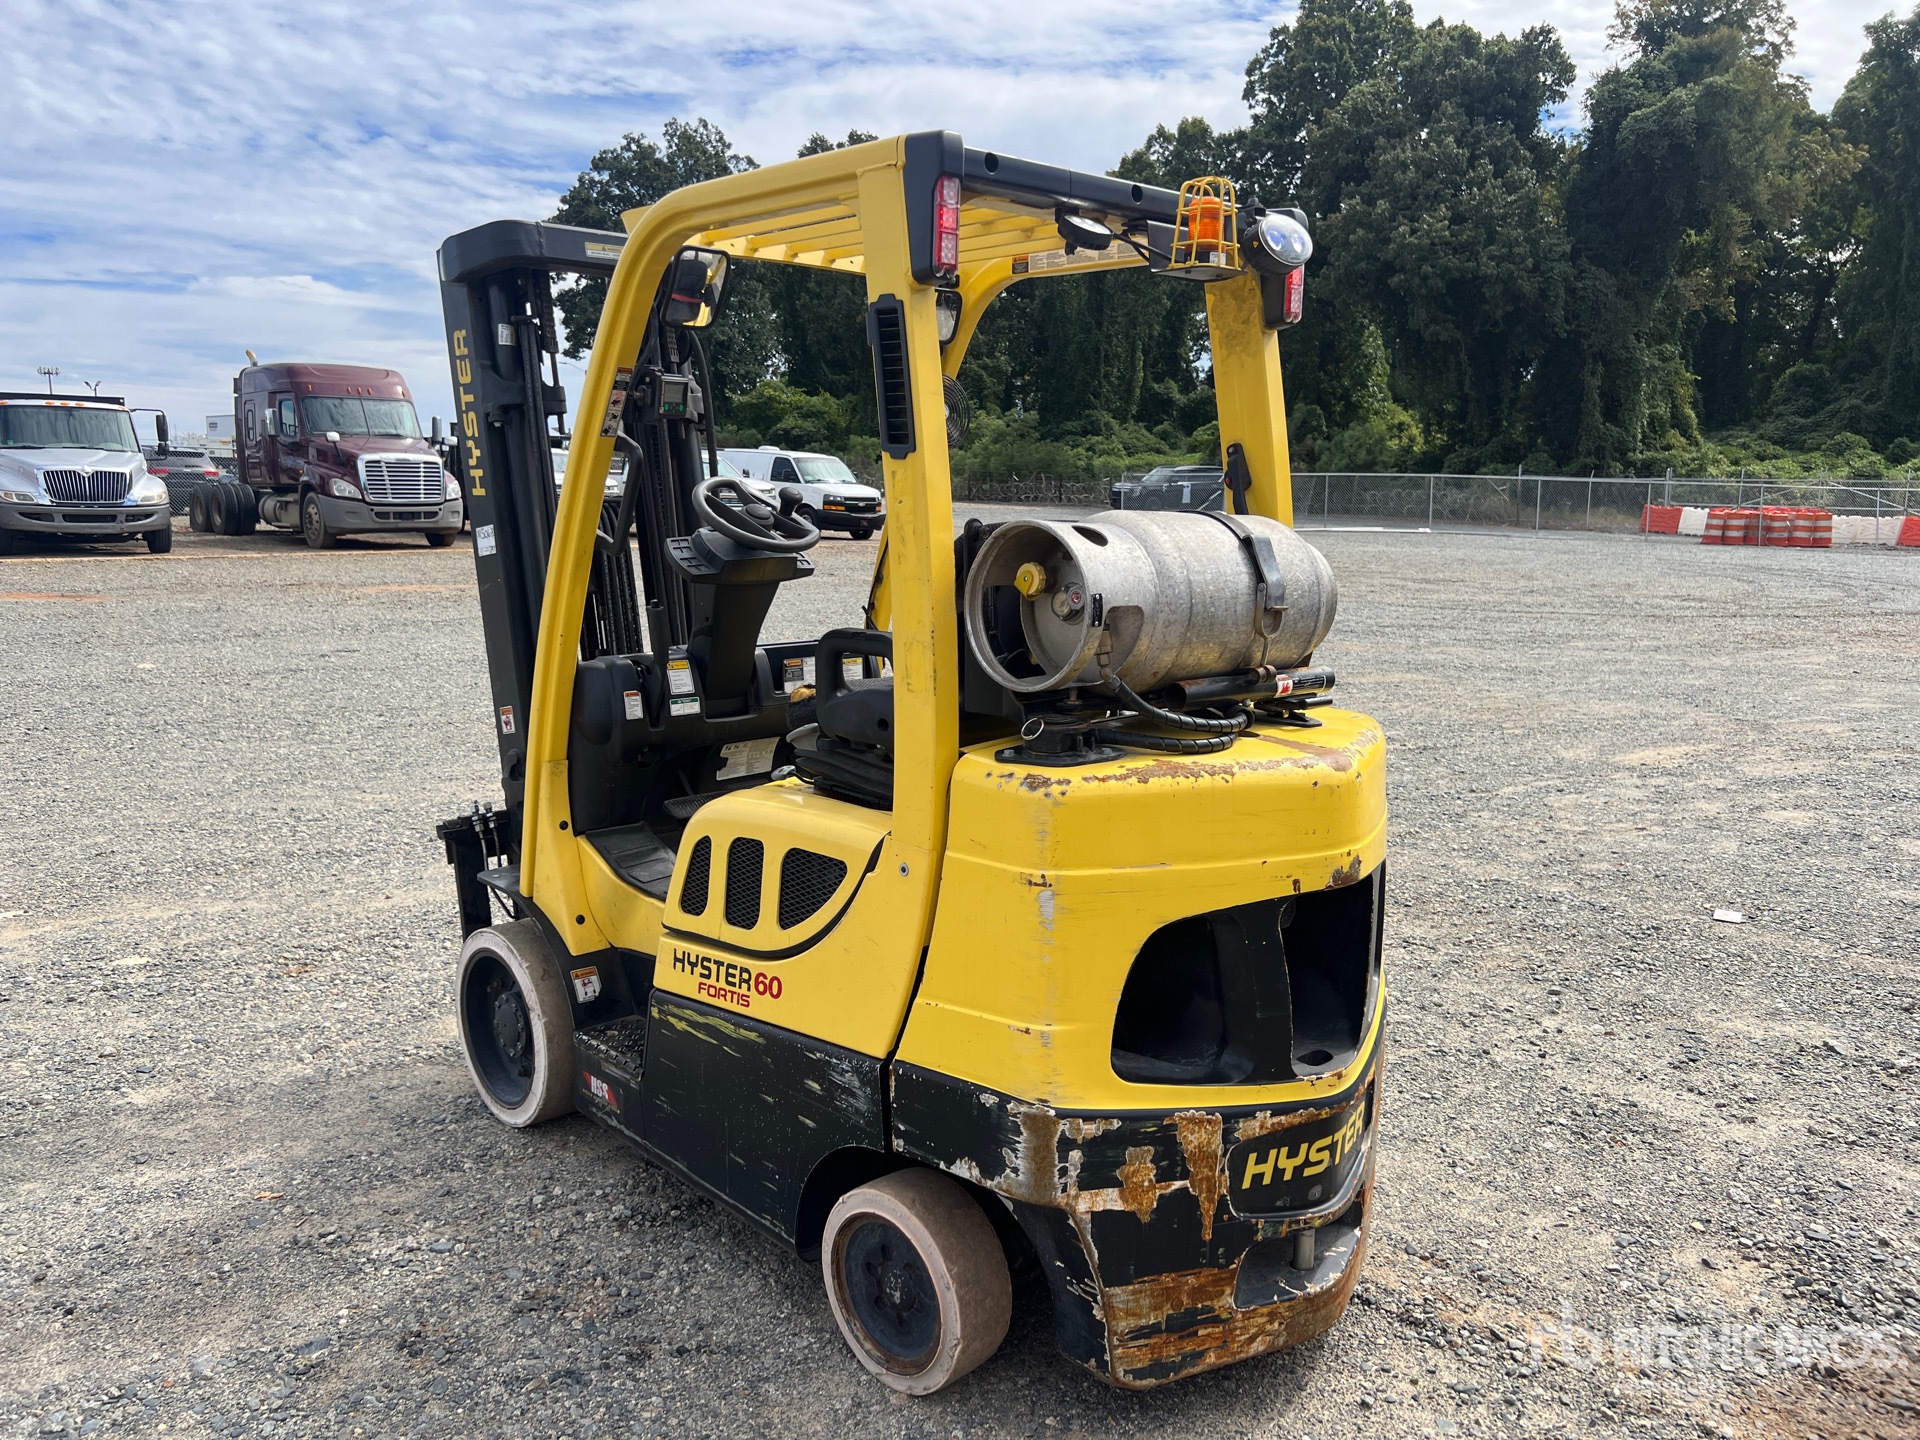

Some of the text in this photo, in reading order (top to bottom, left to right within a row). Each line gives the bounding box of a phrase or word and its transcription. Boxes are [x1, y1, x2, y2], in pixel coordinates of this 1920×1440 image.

[453, 329, 486, 496] HYSTER
[673, 948, 782, 999] HYSTER 60
[697, 981, 750, 1008] FORTIS
[1241, 1101, 1366, 1189] HYSTER
